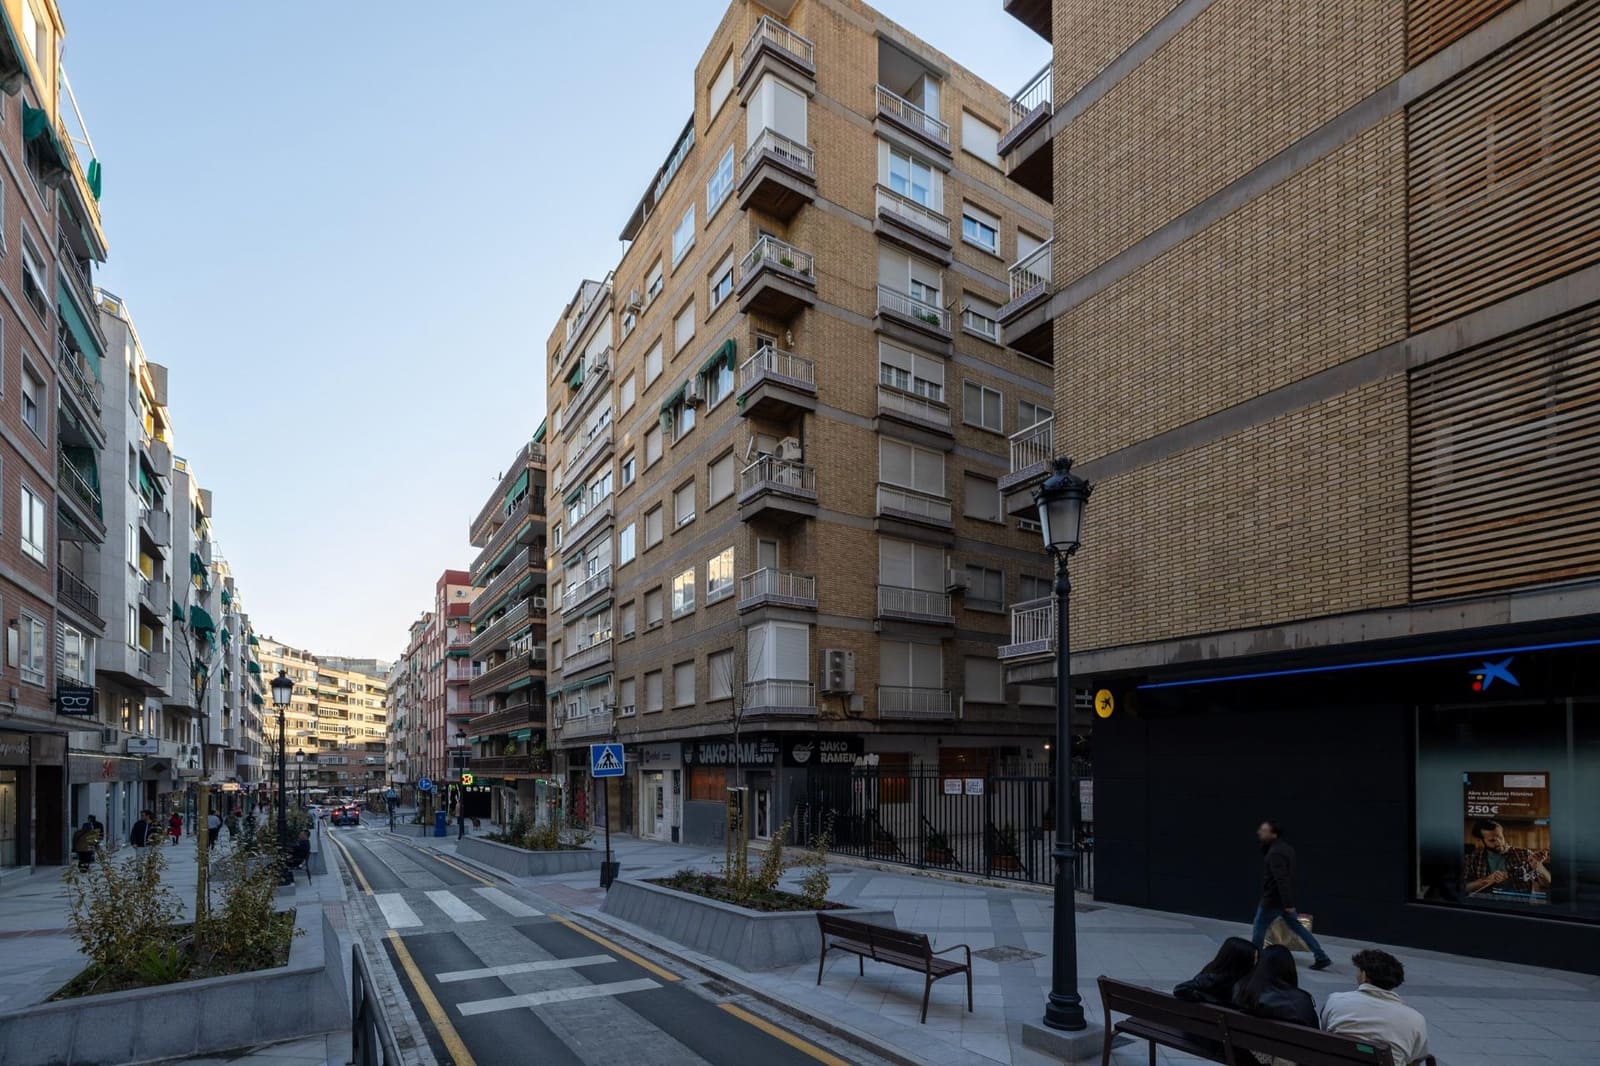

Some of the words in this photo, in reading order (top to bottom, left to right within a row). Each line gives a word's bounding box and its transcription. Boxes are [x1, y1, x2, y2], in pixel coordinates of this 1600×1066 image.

[820, 741, 848, 751] JAKO
[699, 744, 728, 764] JAKO
[820, 752, 857, 763] RAMEN
